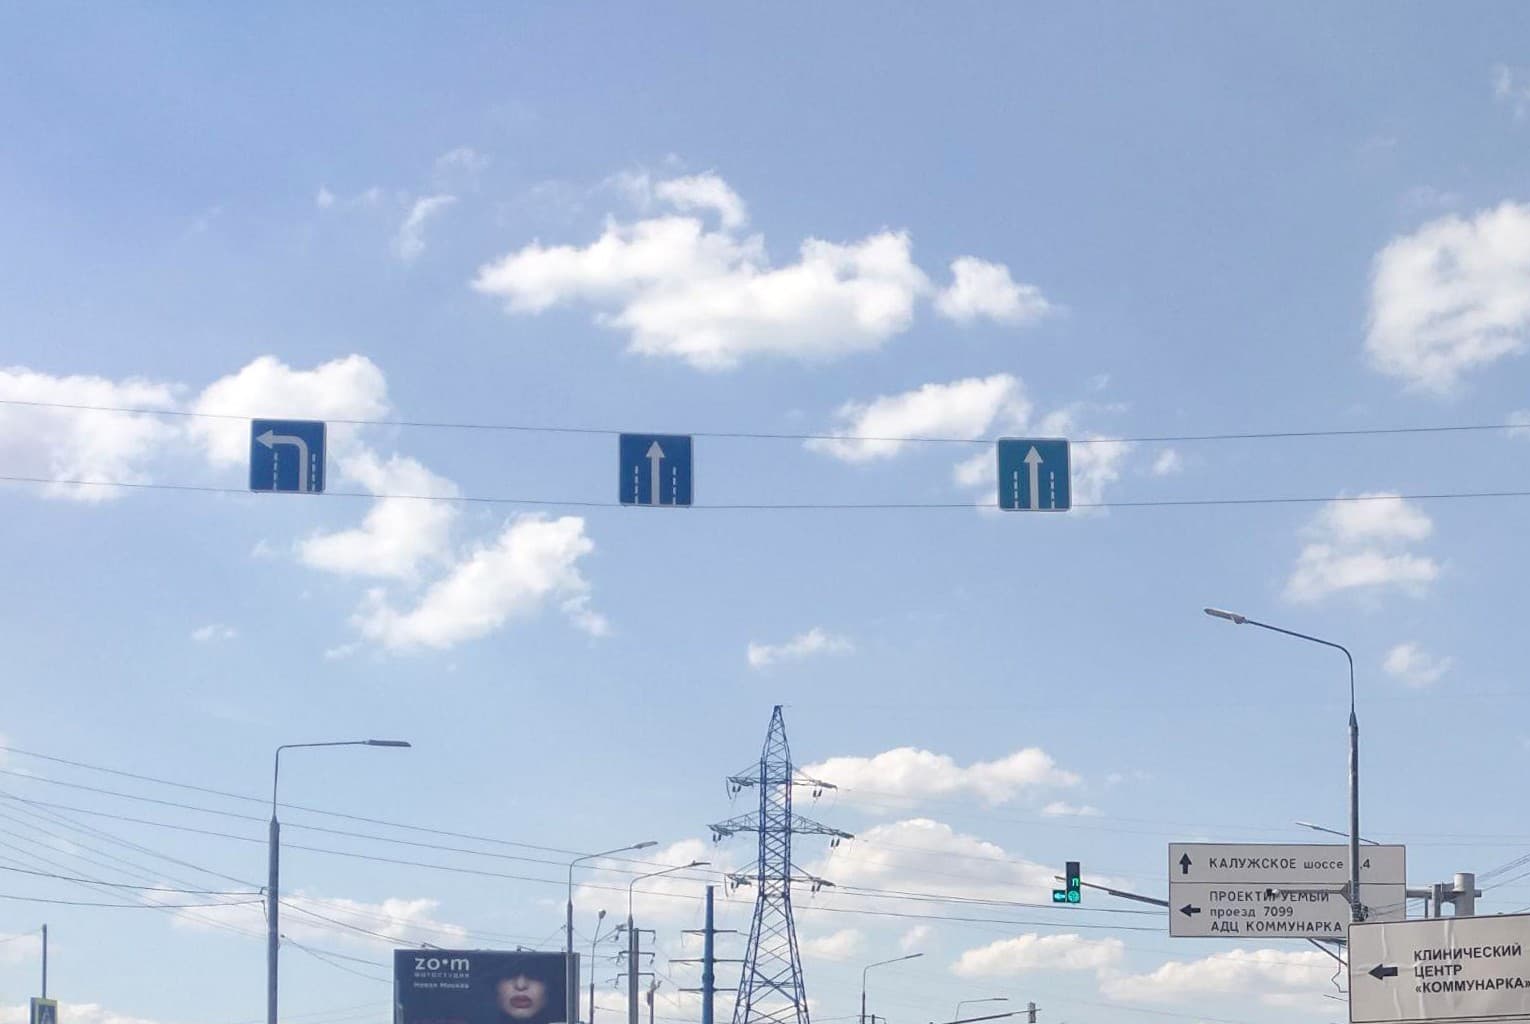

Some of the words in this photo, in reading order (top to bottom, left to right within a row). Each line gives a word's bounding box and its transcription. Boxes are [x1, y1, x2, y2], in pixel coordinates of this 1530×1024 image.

[1209, 857, 1297, 869] КАЛУЖСКОЕ
[1304, 860, 1344, 869] шоссе
[1210, 908, 1256, 918] проезд
[1264, 906, 1294, 917] 7099
[1210, 921, 1239, 933] АДЦ
[1246, 921, 1342, 932] КОММУНАРКА
[1414, 942, 1522, 962] КЛИНИЧЕСКИЙ
[1414, 964, 1463, 979] ЦЕНТР
